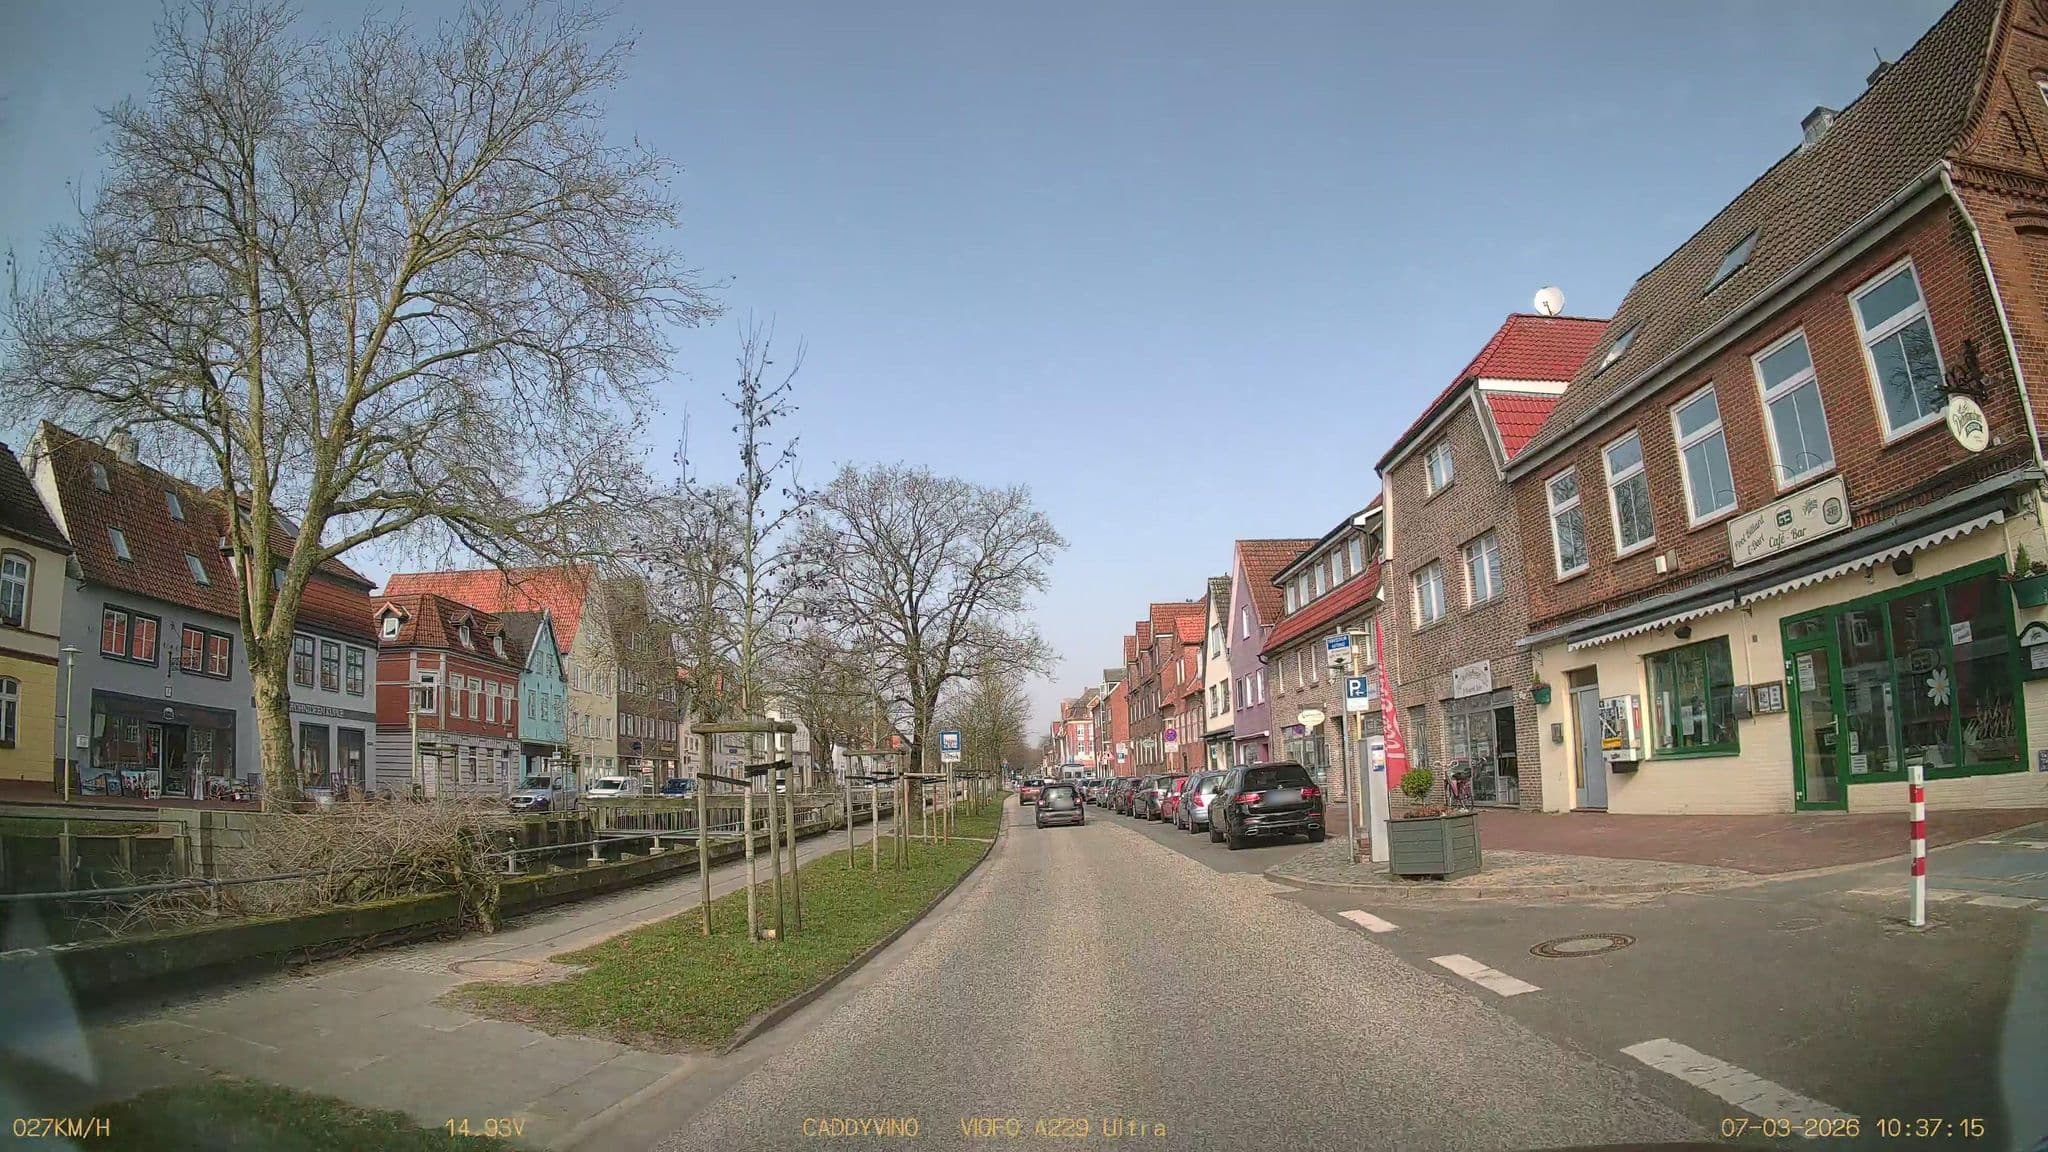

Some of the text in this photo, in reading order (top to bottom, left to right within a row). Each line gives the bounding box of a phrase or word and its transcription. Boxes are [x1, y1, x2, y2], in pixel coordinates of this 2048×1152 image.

[1769, 533, 1785, 549] Café
[1791, 528, 1806, 539] Bar
[1349, 680, 1361, 697] P
